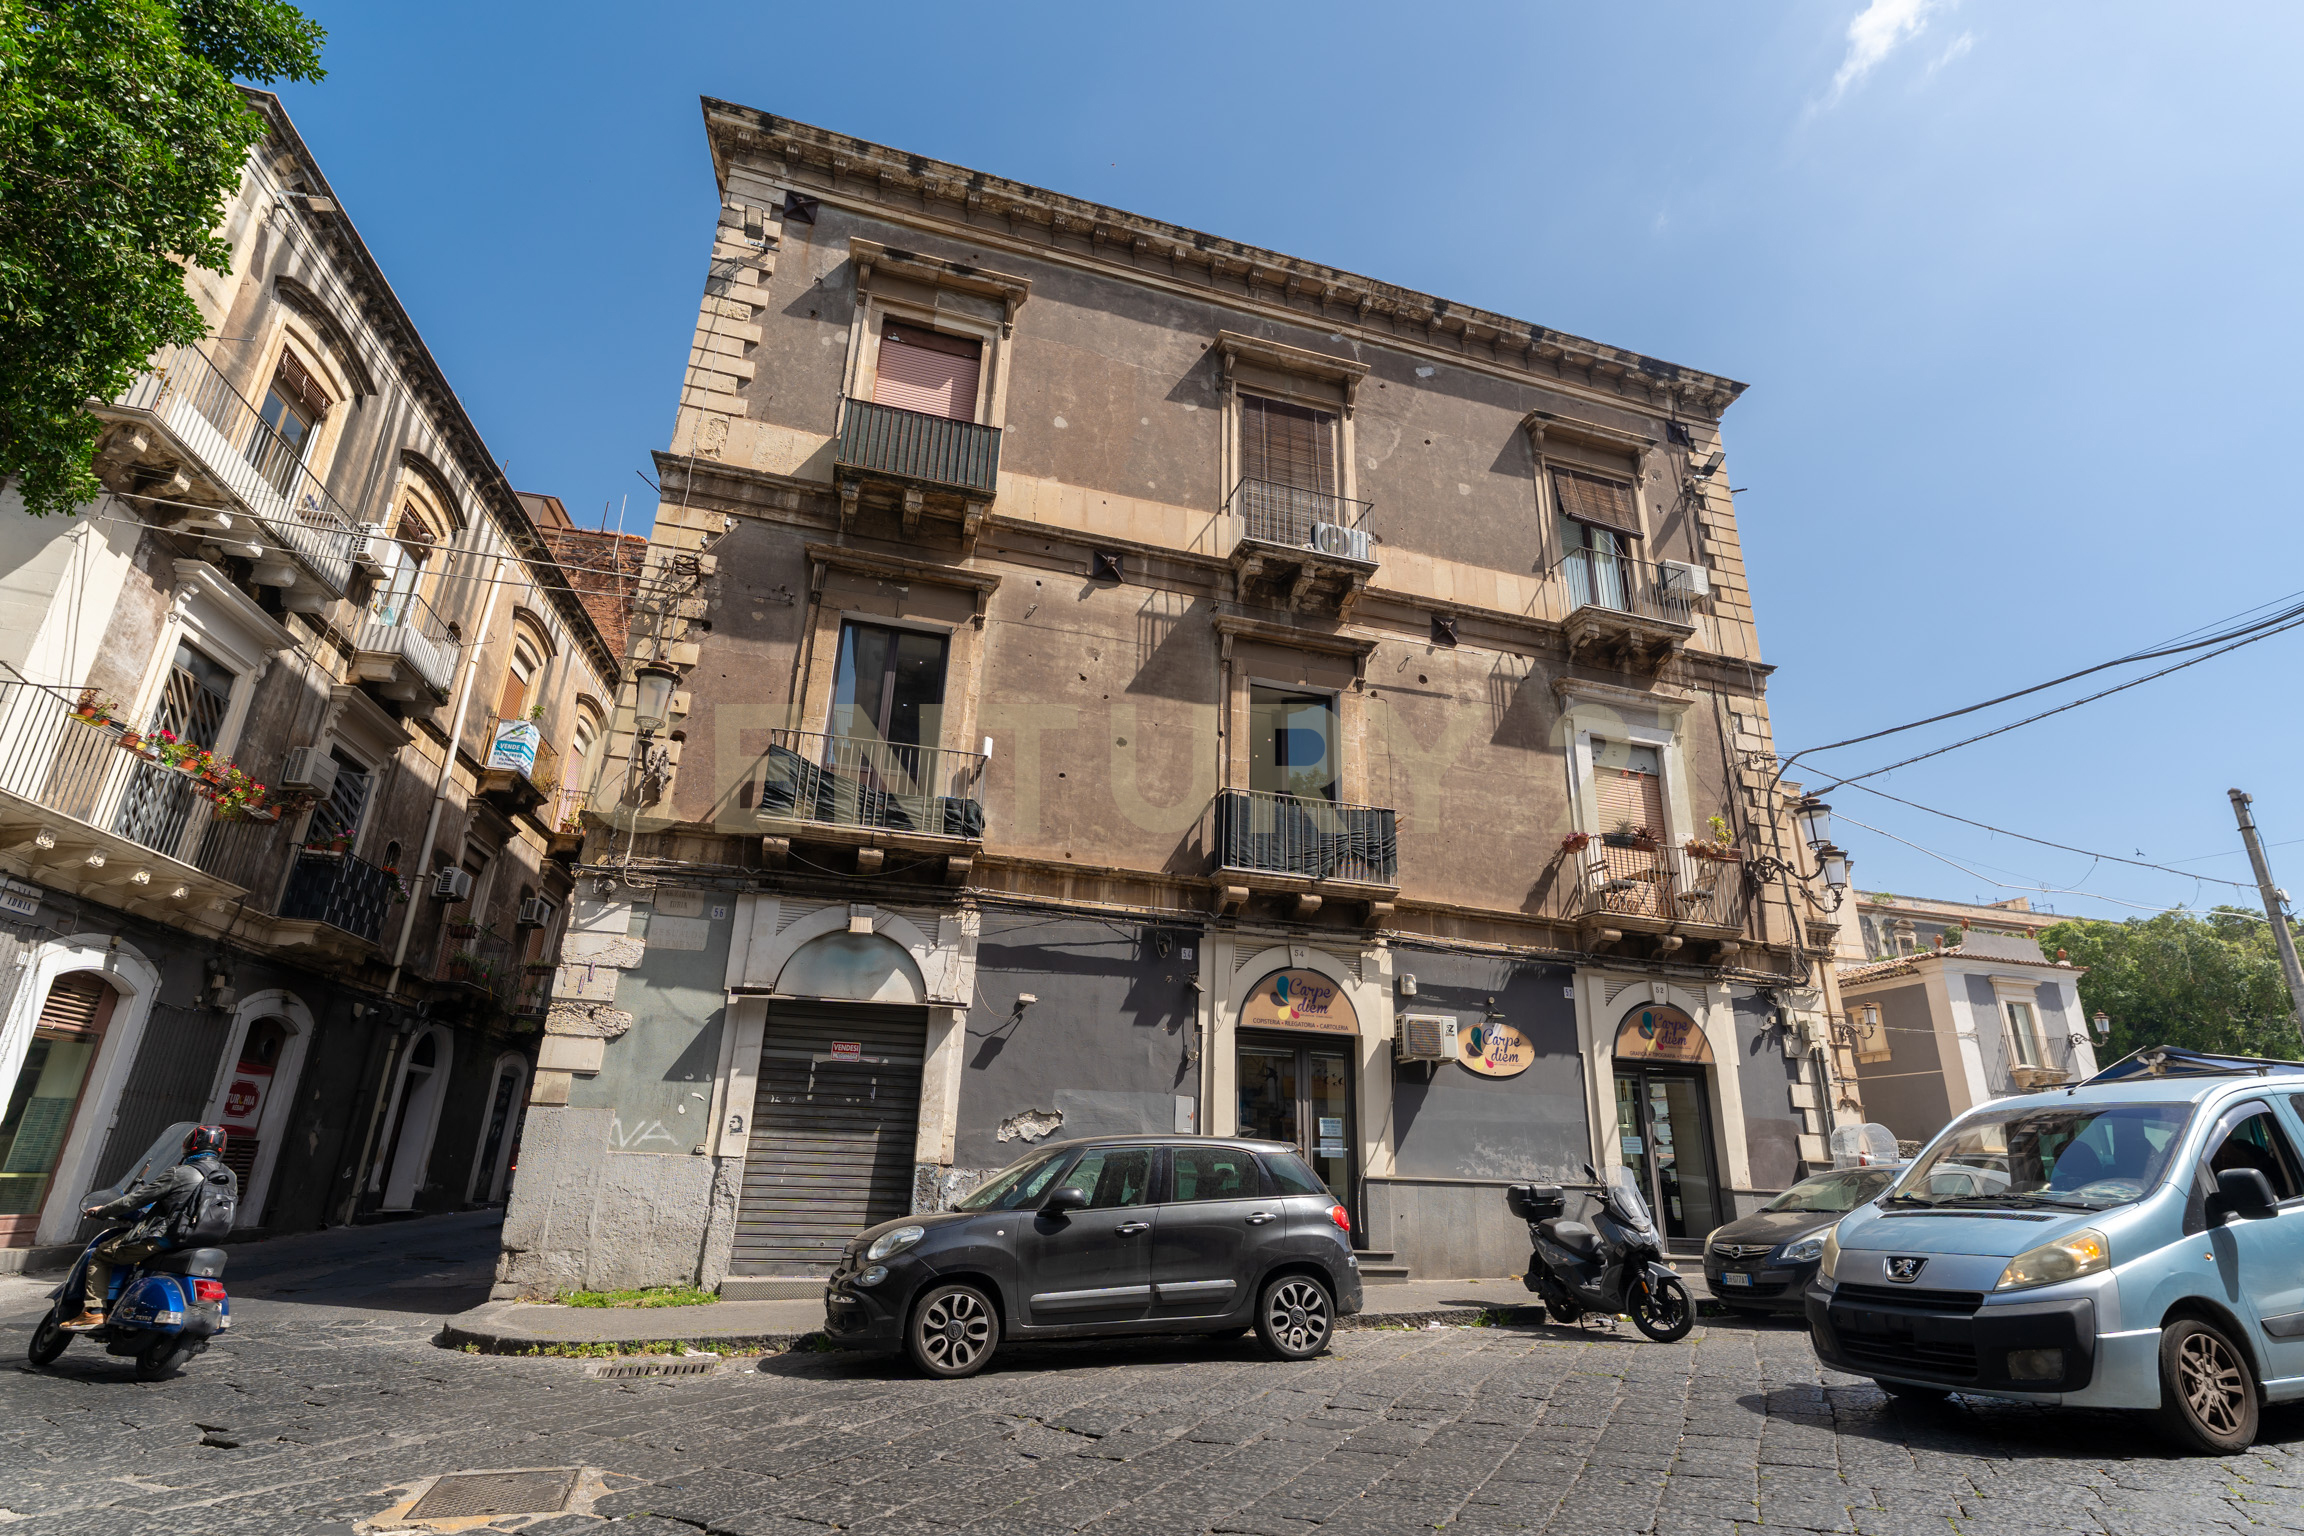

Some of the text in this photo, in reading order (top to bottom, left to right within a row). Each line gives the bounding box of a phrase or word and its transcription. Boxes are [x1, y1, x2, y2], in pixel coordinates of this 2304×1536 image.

[500, 742, 520, 750] VENDE
[664, 889, 697, 899] SEZIONE
[7, 897, 31, 911] IDRIA
[669, 901, 688, 909] IDRIA
[713, 908, 724, 918] 56
[673, 919, 689, 928] VIA
[651, 928, 706, 939] GESUALDO
[651, 939, 703, 950] CLEMENTI
[1183, 949, 1191, 959] 54
[1294, 949, 1304, 958] 54
[1289, 977, 1333, 1004] Carpe
[1565, 988, 1573, 997] 52
[1655, 986, 1664, 994] 52
[1297, 997, 1328, 1015] diem
[1252, 1017, 1349, 1031] COPISTERIA RILEGATORIA CARTOLERIA
[1653, 1013, 1689, 1037] Carpe
[1482, 1028, 1522, 1053] Carpe
[1661, 1030, 1687, 1046] diem
[833, 1043, 859, 1052] VENDESI
[1490, 1046, 1519, 1063] diem
[226, 1093, 255, 1106] TURCHIA
